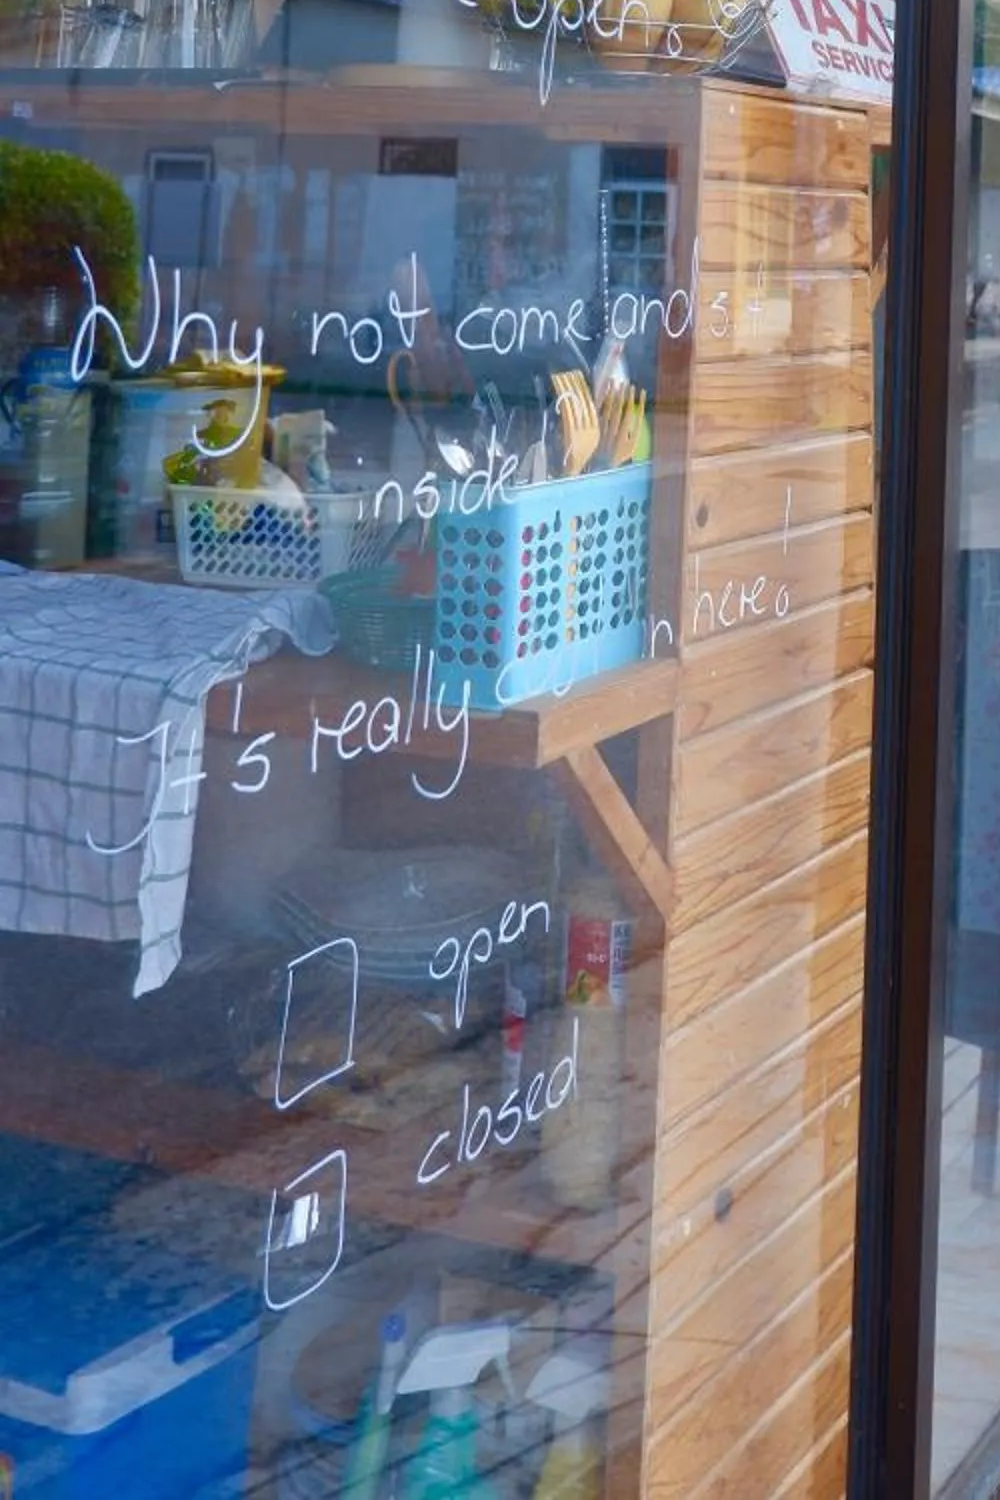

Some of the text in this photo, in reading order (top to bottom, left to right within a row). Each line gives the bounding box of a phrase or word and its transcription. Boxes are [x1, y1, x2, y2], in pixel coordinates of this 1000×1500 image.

[70, 245, 264, 457] Why
[310, 251, 432, 364] not
[455, 298, 592, 355] come
[611, 235, 700, 339] and
[356, 423, 519, 525] inside
[311, 643, 471, 799] really
[428, 900, 550, 1029] open
[416, 1016, 580, 1185] closed
